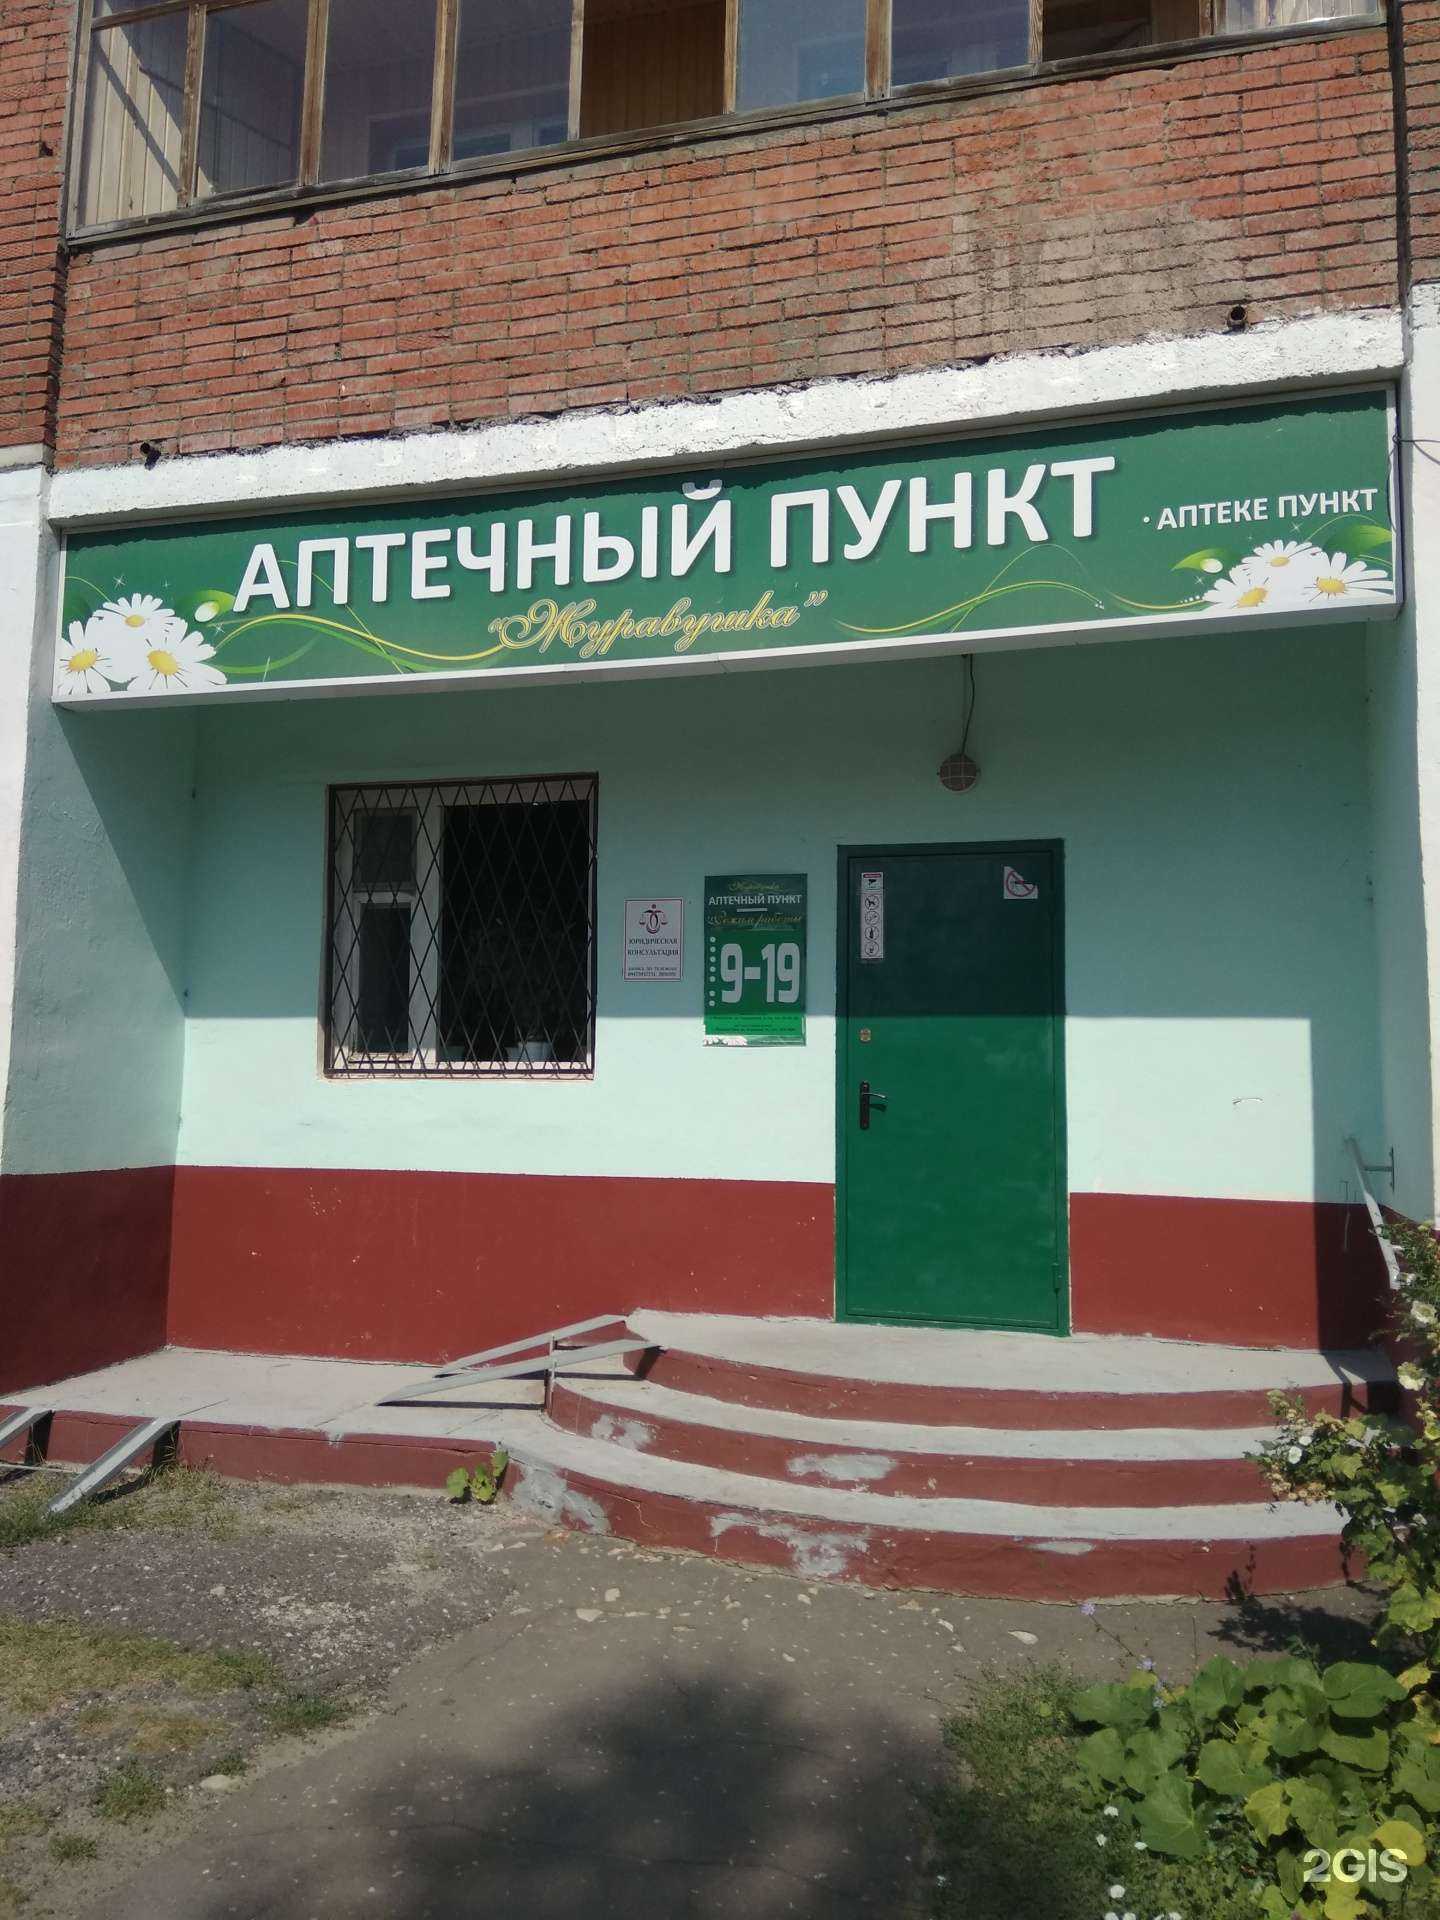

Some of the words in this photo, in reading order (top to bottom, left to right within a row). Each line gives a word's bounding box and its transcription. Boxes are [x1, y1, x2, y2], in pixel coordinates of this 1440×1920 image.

[233, 479, 732, 613] АПТЕЧНЫЙ
[769, 456, 1116, 568] ПУНКТ
[1156, 497, 1269, 530] АПТЕКЕ
[1278, 488, 1378, 518] ПУНКТ
[708, 892, 765, 906] АПТЕЧНЫЙ
[767, 894, 803, 905] ПУНКТ
[720, 942, 801, 1004] 9-19
